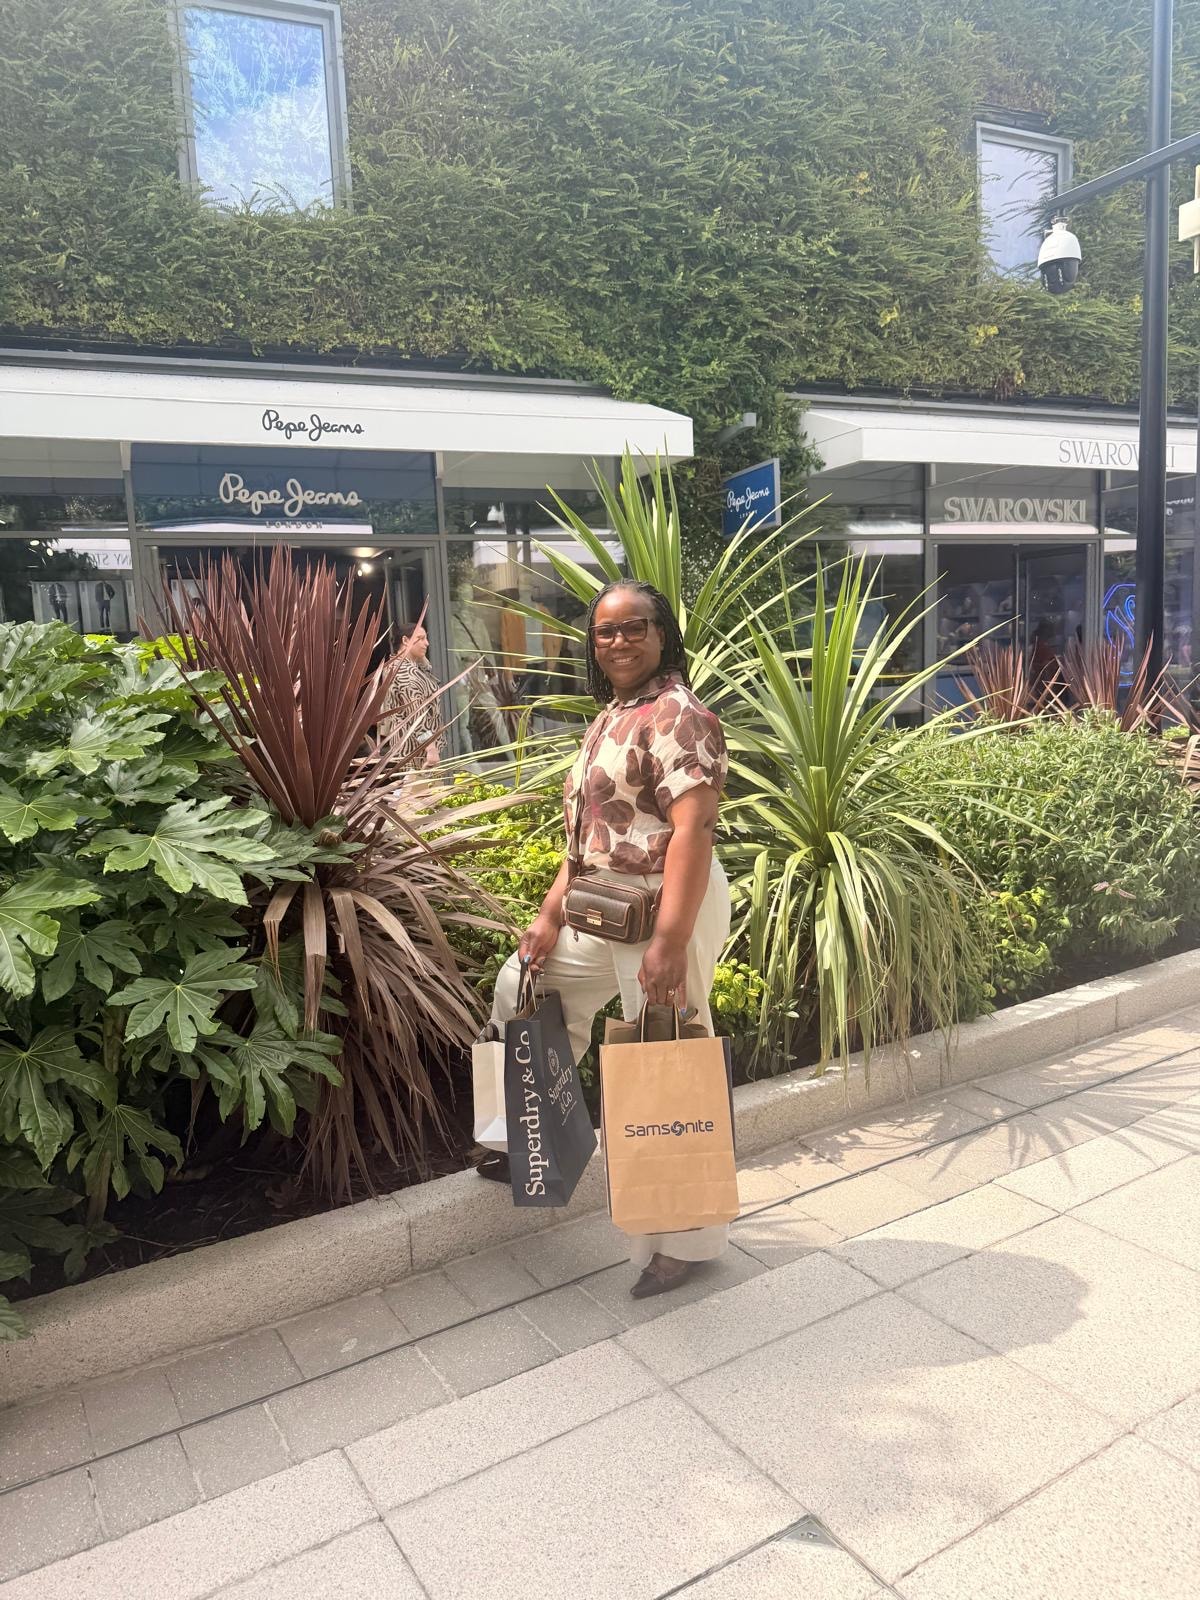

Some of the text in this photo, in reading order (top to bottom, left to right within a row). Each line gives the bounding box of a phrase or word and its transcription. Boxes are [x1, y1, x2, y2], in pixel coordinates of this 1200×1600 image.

[262, 409, 365, 441] Pepe Jeans
[219, 473, 362, 517] Pepe Jeans
[726, 486, 770, 513] Pepe Jeans
[944, 497, 1087, 522] SWAROVSKI
[265, 520, 323, 529] LONDON
[515, 1030, 549, 1196] Superdry & Co
[624, 1119, 715, 1138] Samsonite
